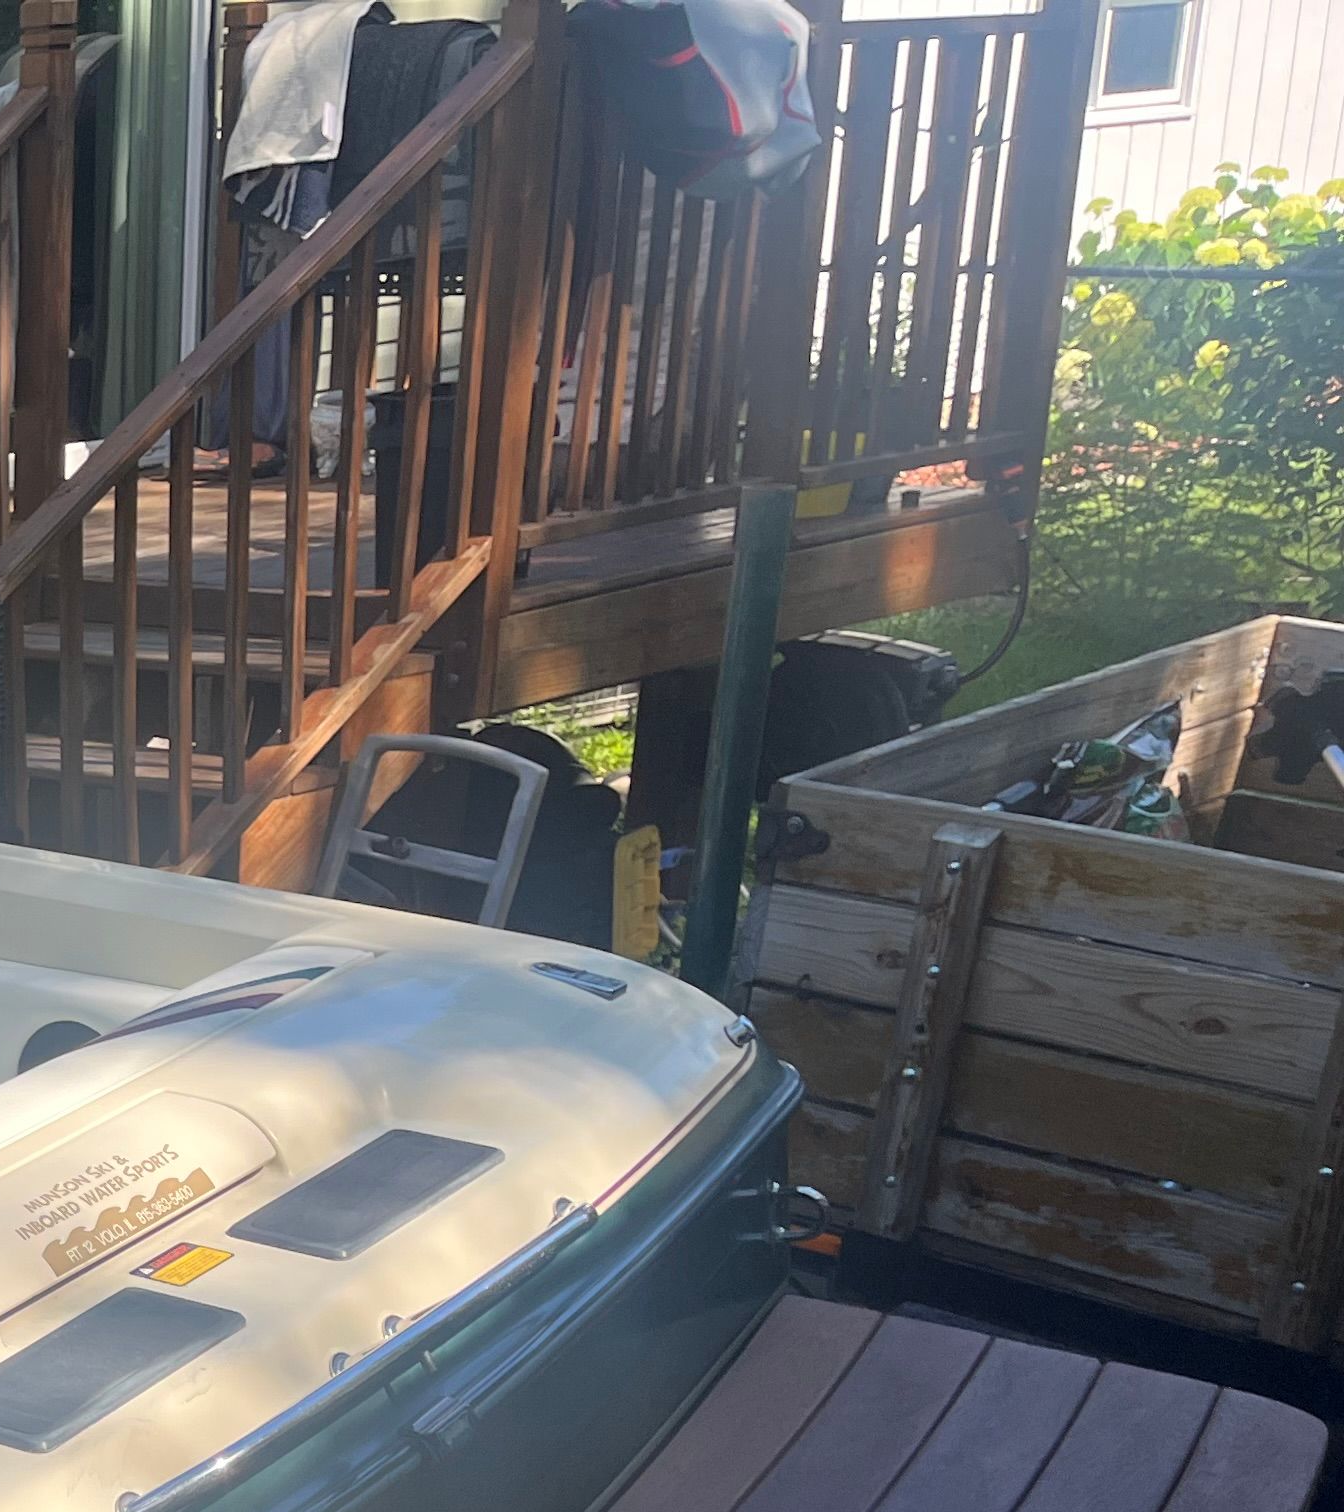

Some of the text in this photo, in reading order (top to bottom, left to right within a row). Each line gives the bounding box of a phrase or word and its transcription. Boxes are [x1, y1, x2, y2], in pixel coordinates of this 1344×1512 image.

[14, 1143, 179, 1240] INBOARD WATER SPORTS
[23, 1174, 91, 1213] MUNSON
[112, 1155, 130, 1166] &
